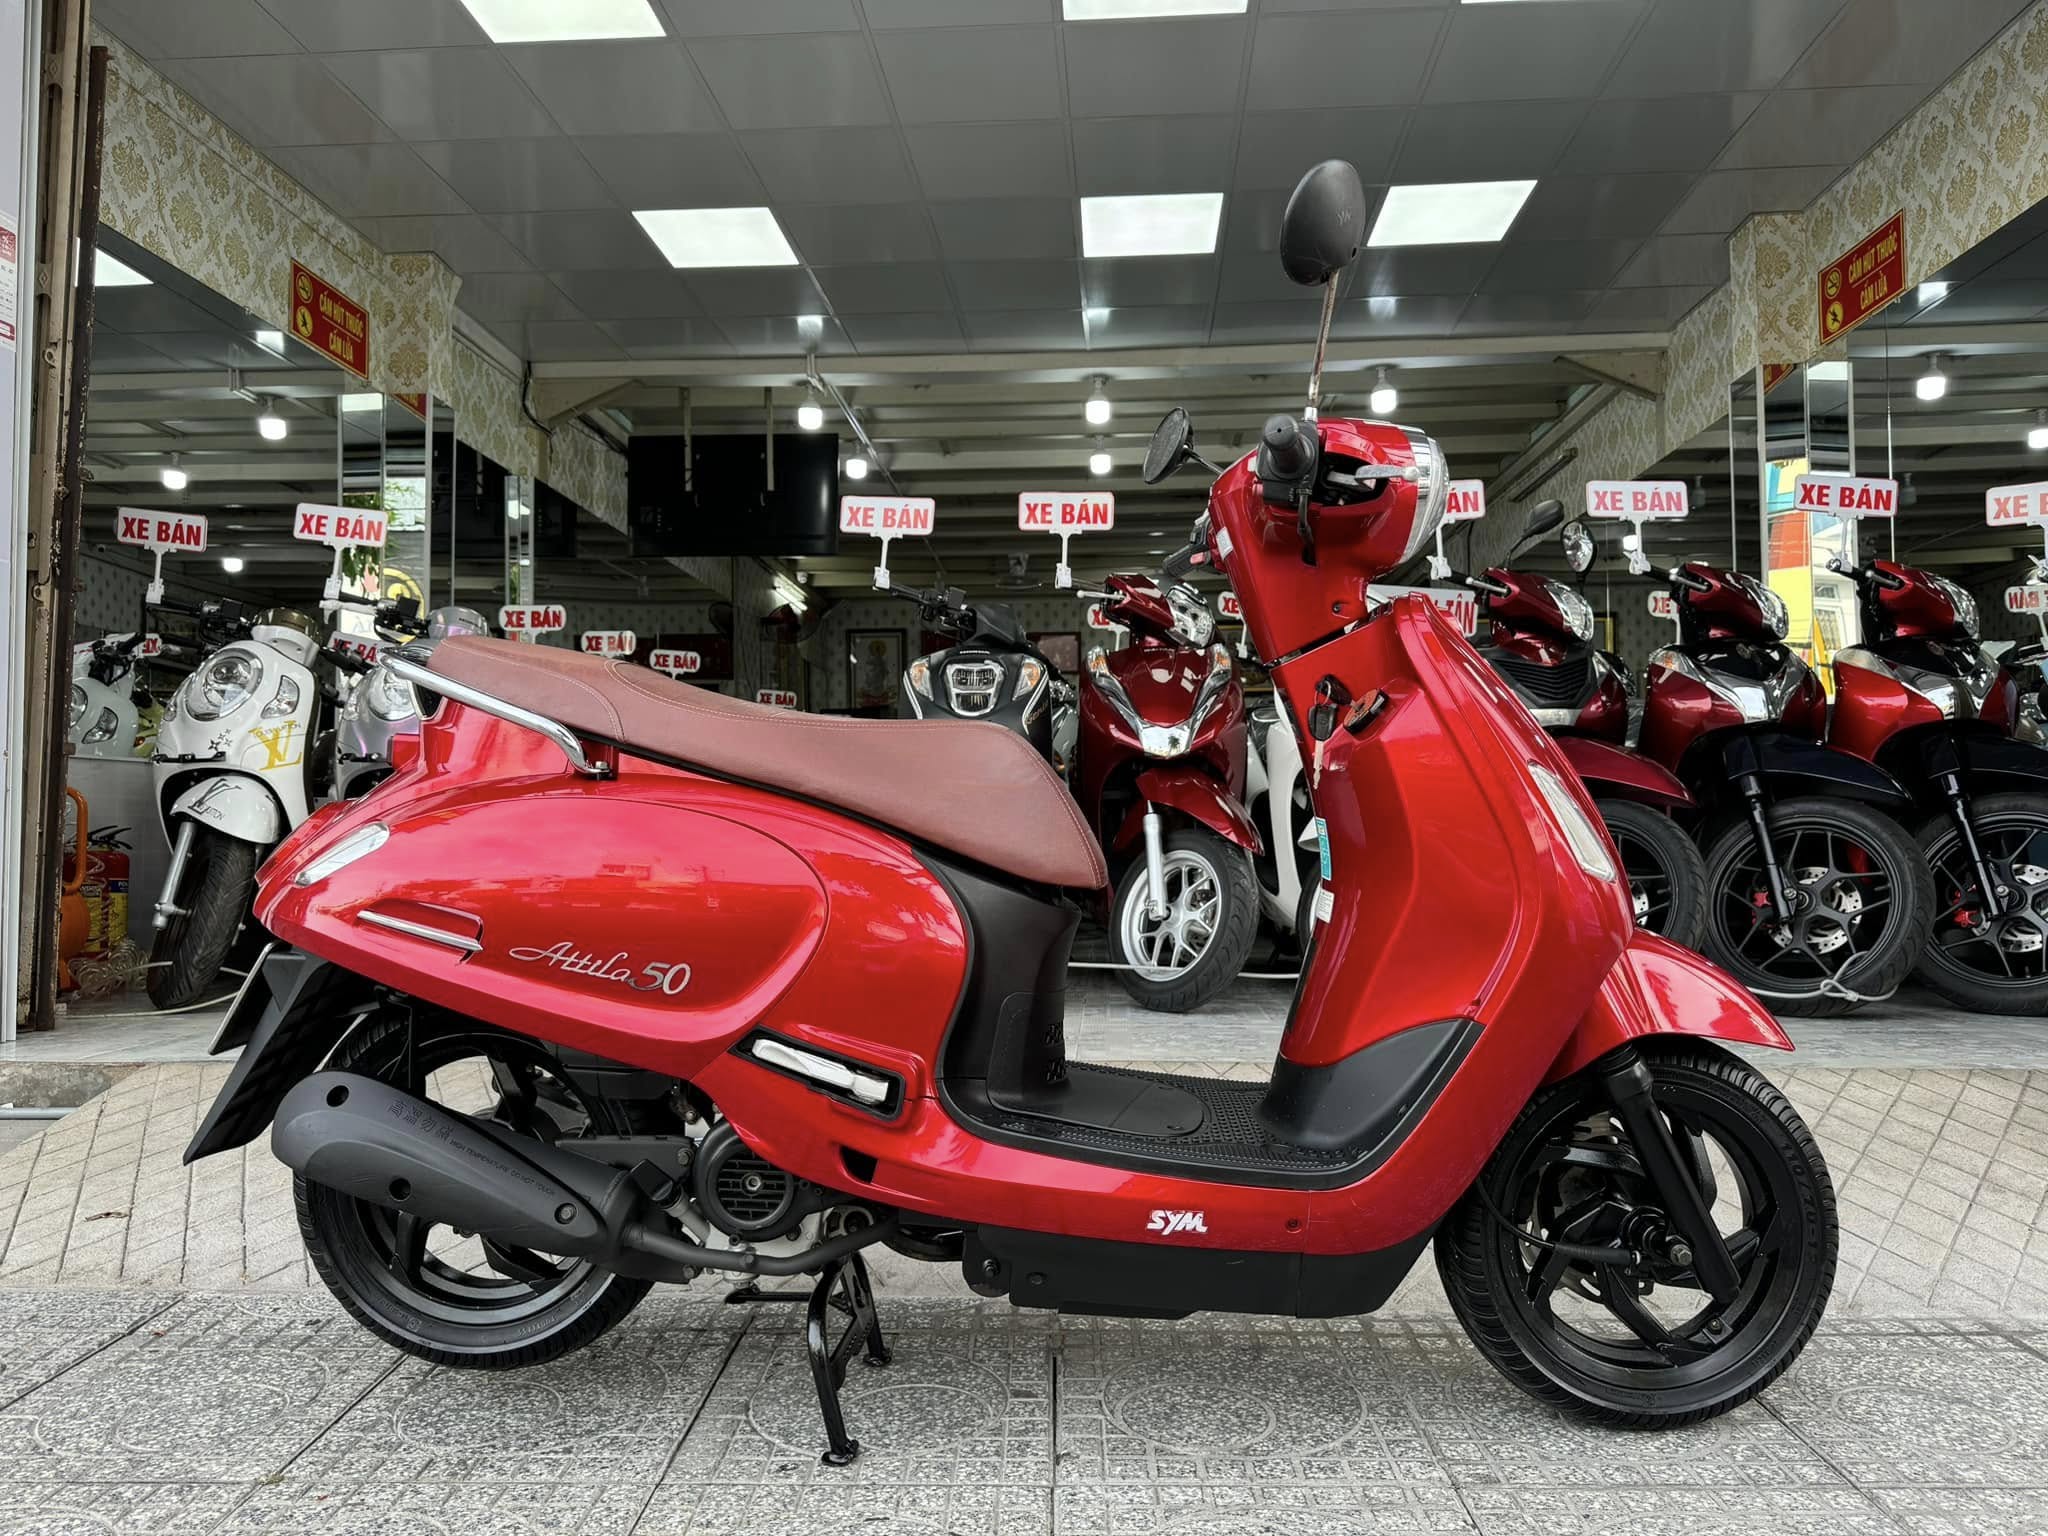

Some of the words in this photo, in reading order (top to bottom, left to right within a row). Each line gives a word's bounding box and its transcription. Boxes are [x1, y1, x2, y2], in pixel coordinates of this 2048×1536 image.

[1446, 487, 1480, 513] ÁN
[1594, 490, 1623, 512] XE
[1632, 487, 1683, 512] BÁN
[1799, 483, 1830, 506] XE
[1839, 483, 1892, 512] BÁN
[1993, 495, 2029, 520] XE
[846, 506, 874, 528] XE
[882, 504, 929, 529] BÁN
[1024, 502, 1053, 525] XE
[1060, 499, 1108, 525] BÁN
[122, 516, 150, 541] XE
[156, 518, 202, 547] BÁN
[298, 512, 329, 537] XE
[334, 511, 382, 542] BÁN
[504, 610, 525, 628] XE
[530, 606, 562, 628] BÁN
[1652, 596, 1671, 614] XE
[585, 634, 604, 651] XE
[654, 654, 670, 668] XE
[673, 653, 697, 670] BÁN
[759, 692, 773, 705] XE
[508, 941, 632, 982] Attila
[636, 962, 692, 995] 50
[1146, 1210, 1208, 1236] SYM
